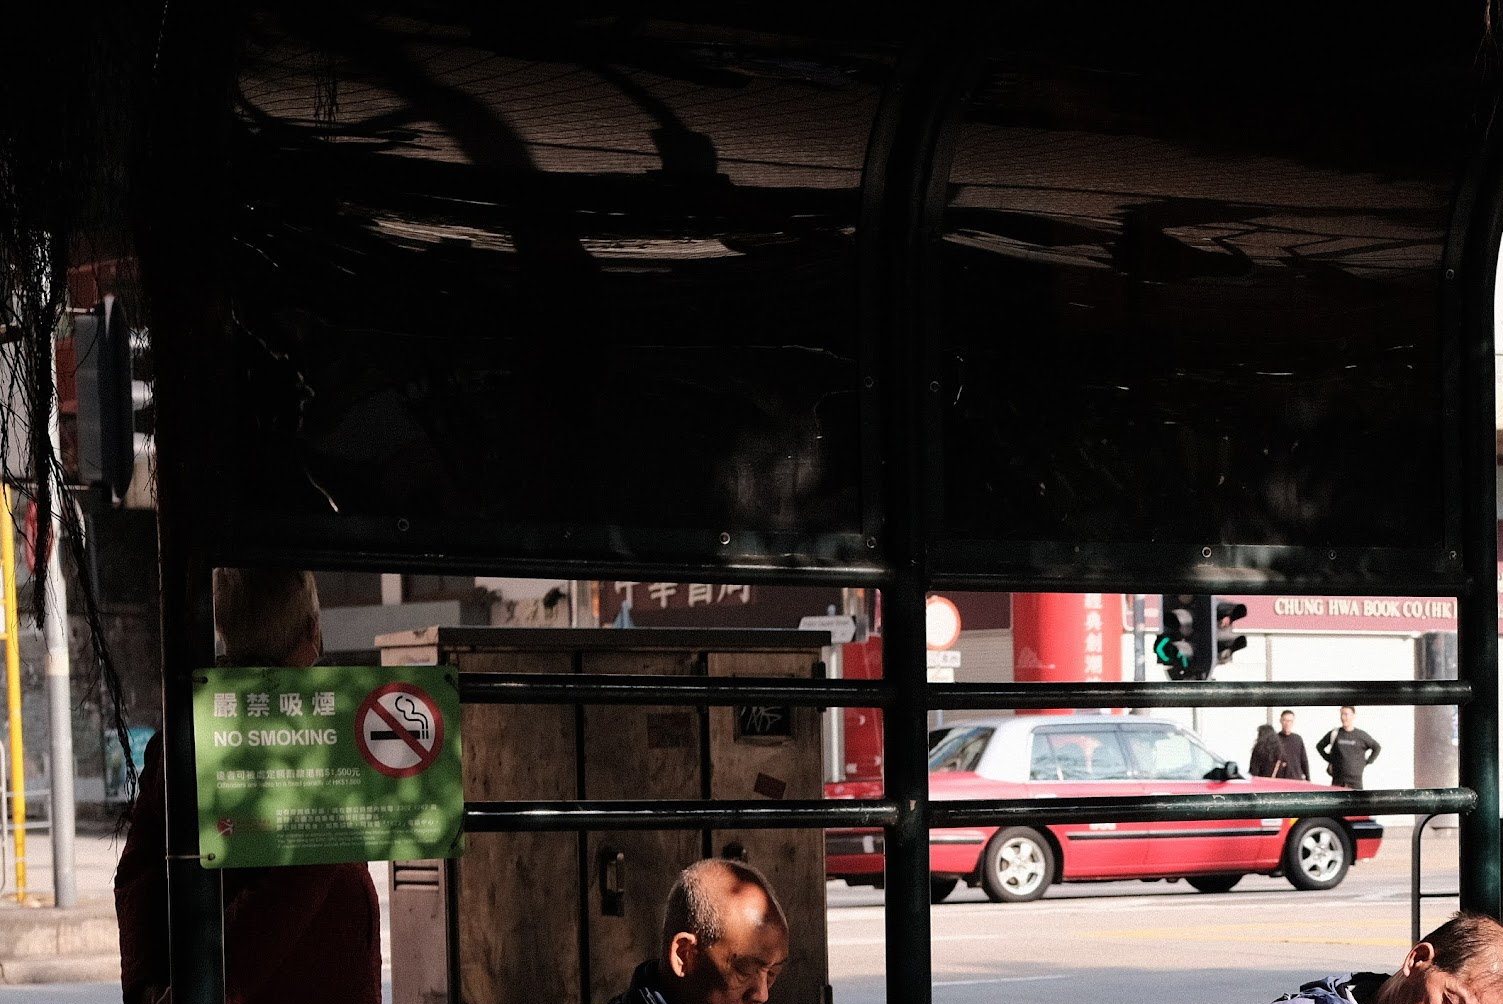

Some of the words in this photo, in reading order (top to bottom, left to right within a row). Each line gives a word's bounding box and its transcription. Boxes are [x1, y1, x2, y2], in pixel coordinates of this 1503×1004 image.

[1274, 597, 1324, 616] CHUNG
[1328, 599, 1360, 616] HWA
[1363, 599, 1401, 618] BOOK
[213, 691, 336, 718] 嚴禁吸煙
[214, 731, 243, 747] NO
[248, 729, 338, 747] SMOKING
